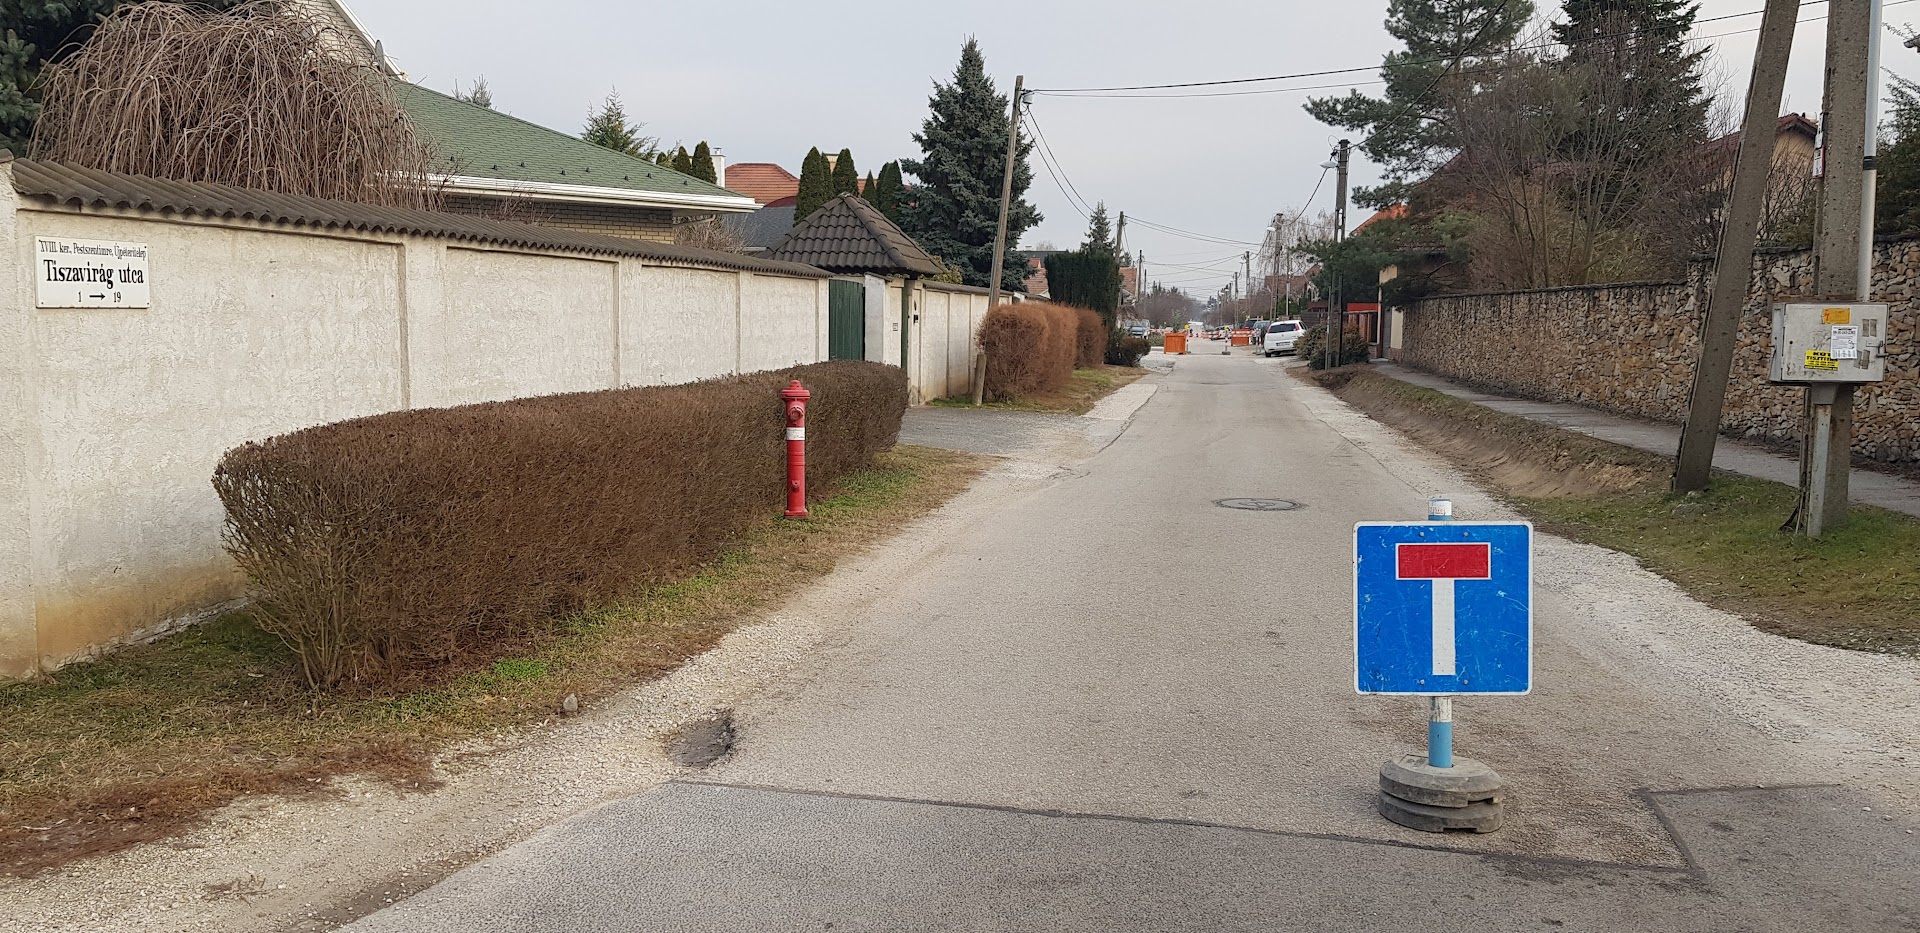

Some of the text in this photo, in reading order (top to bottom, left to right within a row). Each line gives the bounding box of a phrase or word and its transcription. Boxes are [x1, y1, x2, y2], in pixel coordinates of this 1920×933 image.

[40, 240, 57, 253] XVIII.
[73, 243, 114, 257] Pestszentimre,
[43, 259, 144, 289] Tiszavirág utca
[78, 291, 122, 303] 1 19
